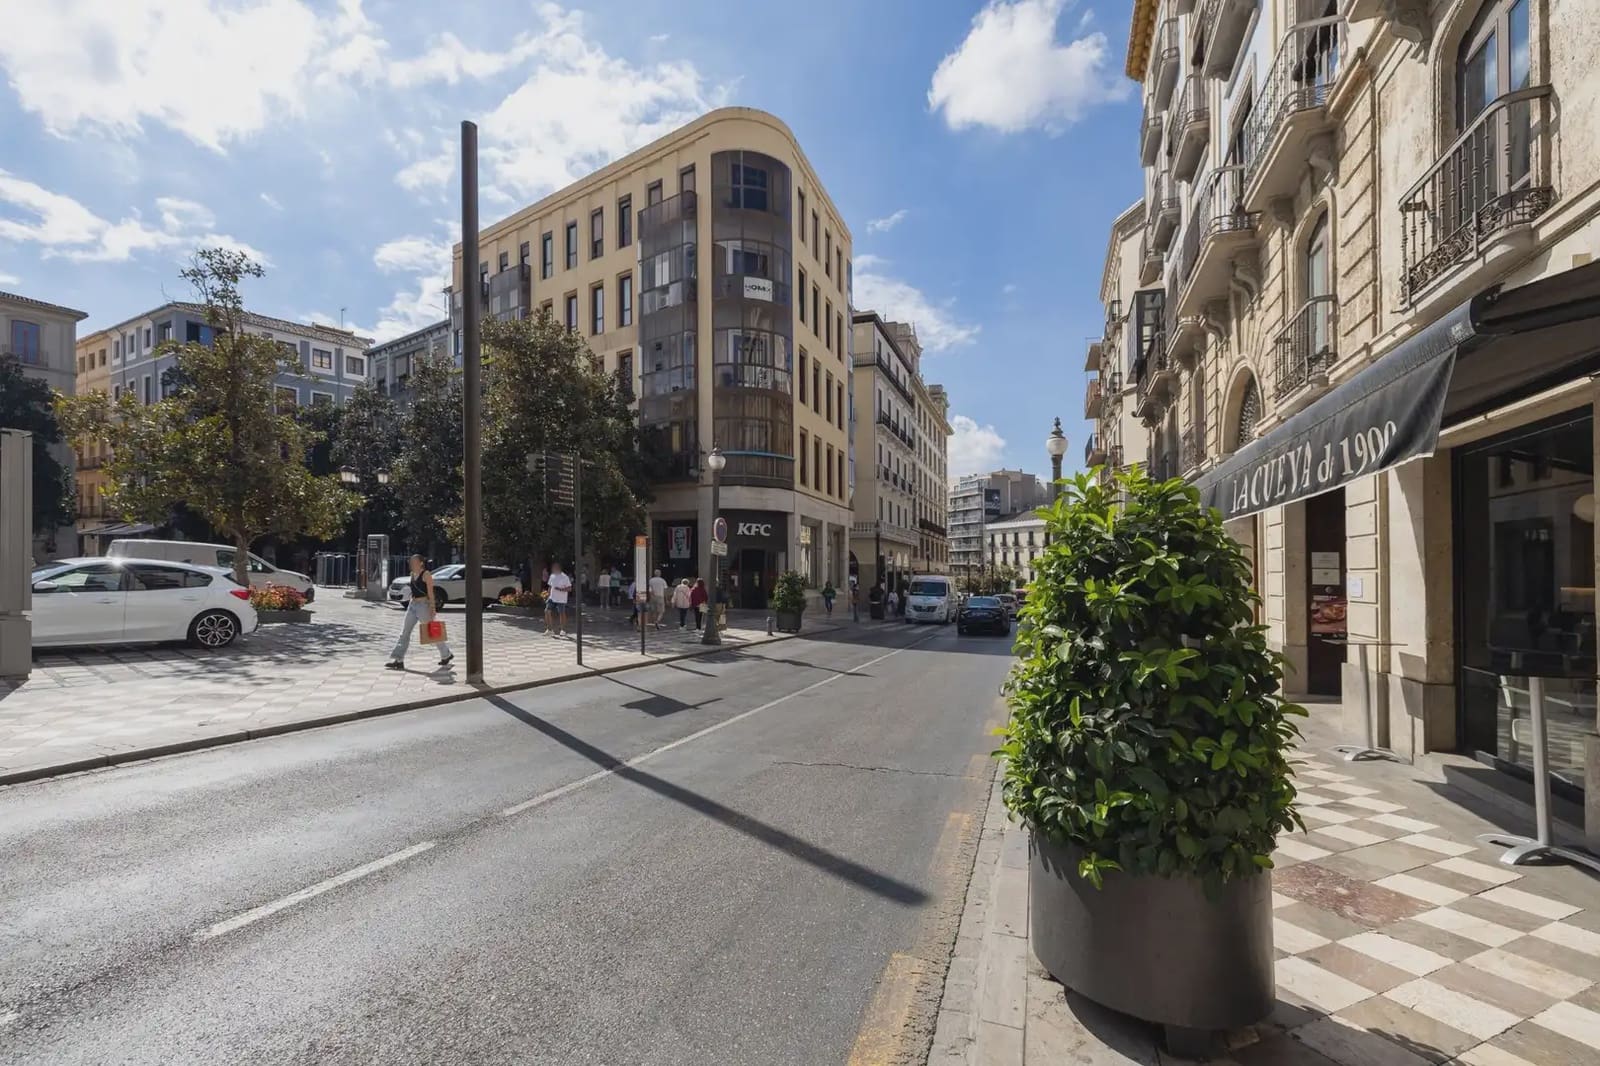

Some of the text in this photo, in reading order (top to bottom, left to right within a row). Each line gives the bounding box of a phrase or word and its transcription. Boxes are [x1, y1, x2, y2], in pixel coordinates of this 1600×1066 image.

[1250, 441, 1312, 506] CUEVA
[1339, 420, 1397, 476] 1900
[736, 522, 772, 537] KFC
